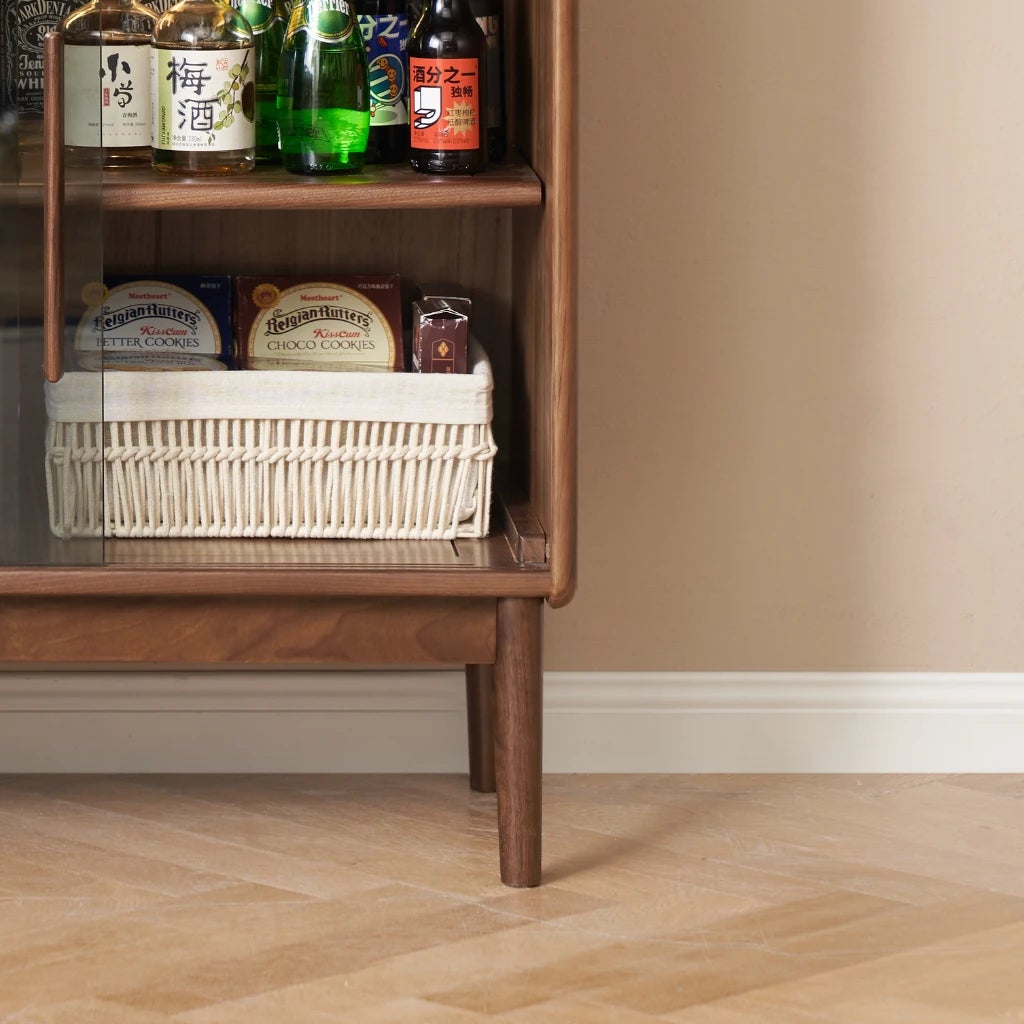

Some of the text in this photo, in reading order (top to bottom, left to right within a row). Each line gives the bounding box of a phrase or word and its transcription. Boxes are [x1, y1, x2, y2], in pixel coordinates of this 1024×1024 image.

[413, 65, 476, 84] 酒分之一
[166, 56, 219, 131] 梅酒
[450, 85, 473, 98] 独畅
[144, 337, 200, 349] COOKIES
[267, 339, 376, 352] CHOCO COOKIES
